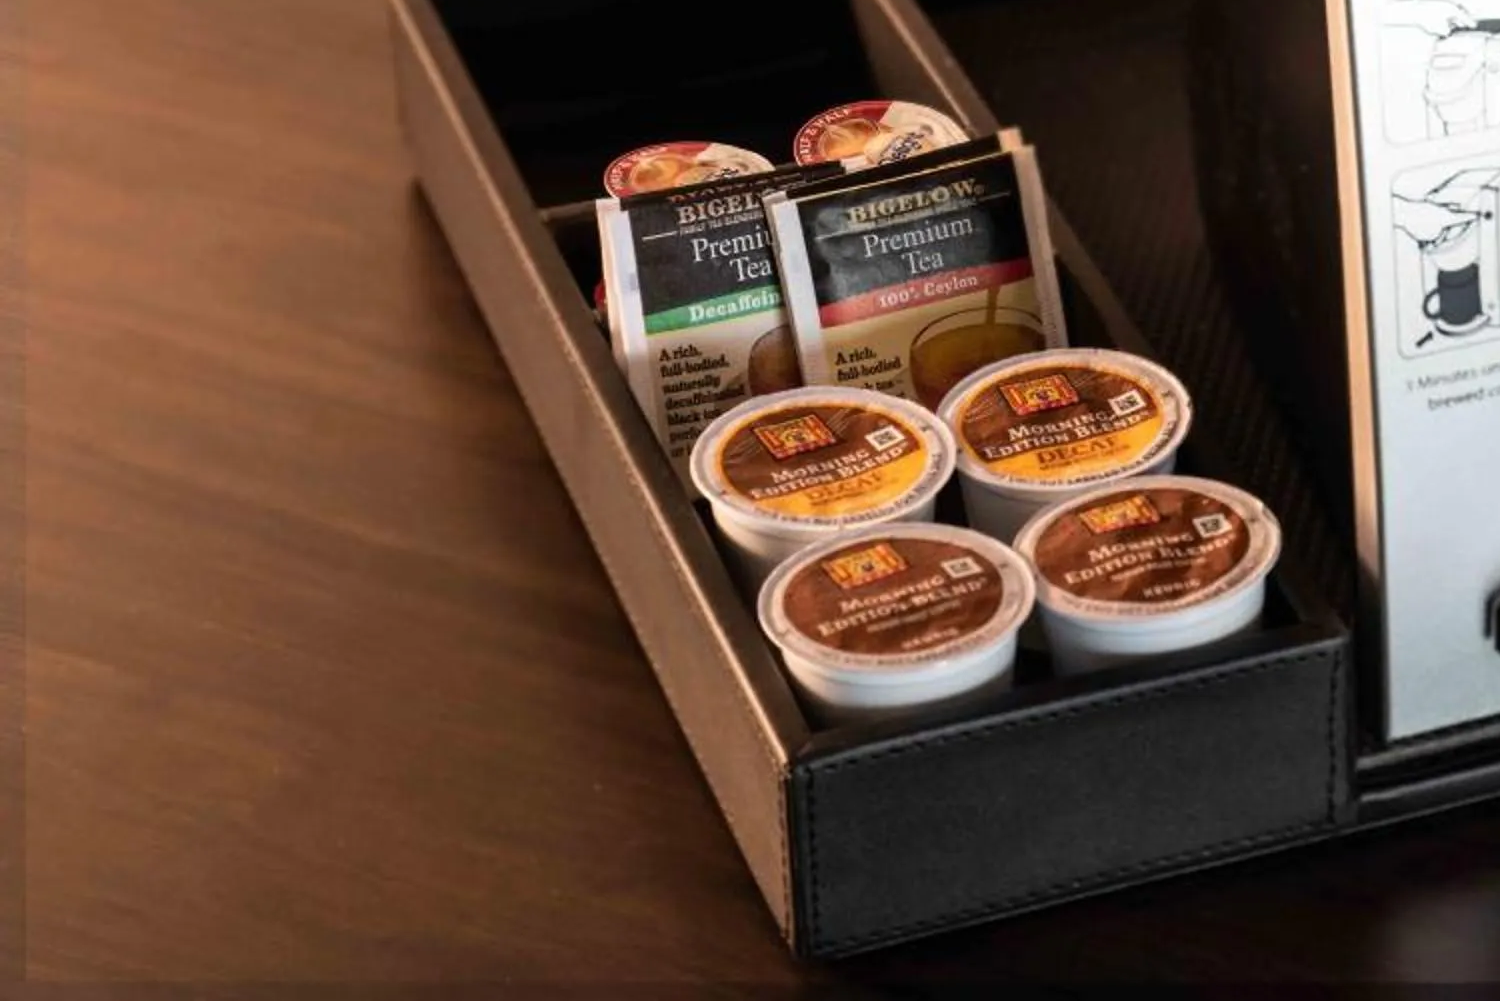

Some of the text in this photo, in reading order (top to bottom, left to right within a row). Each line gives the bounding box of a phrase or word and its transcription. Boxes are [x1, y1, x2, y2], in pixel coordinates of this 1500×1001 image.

[676, 192, 760, 224] BIGEL
[848, 179, 977, 224] BIGELOW
[691, 225, 774, 262] Premiu
[862, 218, 974, 259] Premium
[729, 257, 773, 282] Tea
[902, 250, 944, 274] Tea
[924, 274, 979, 297] Ceylon
[689, 290, 781, 322] Decaffein
[659, 348, 671, 361] A
[835, 351, 847, 366] A
[982, 415, 1142, 460] EDITION BLEND
[1007, 411, 1112, 442] MORNING
[770, 448, 870, 483] MORNING
[1036, 436, 1120, 466] DECAF
[749, 474, 835, 500] EDITION
[835, 447, 904, 479] BLEND
[1063, 551, 1153, 585] EDITION
[1160, 535, 1231, 559] BLEND
[1087, 531, 1194, 563] MORNING
[817, 603, 906, 637] EDITION
[910, 579, 982, 608] BLEND
[838, 573, 946, 613] MORNING
